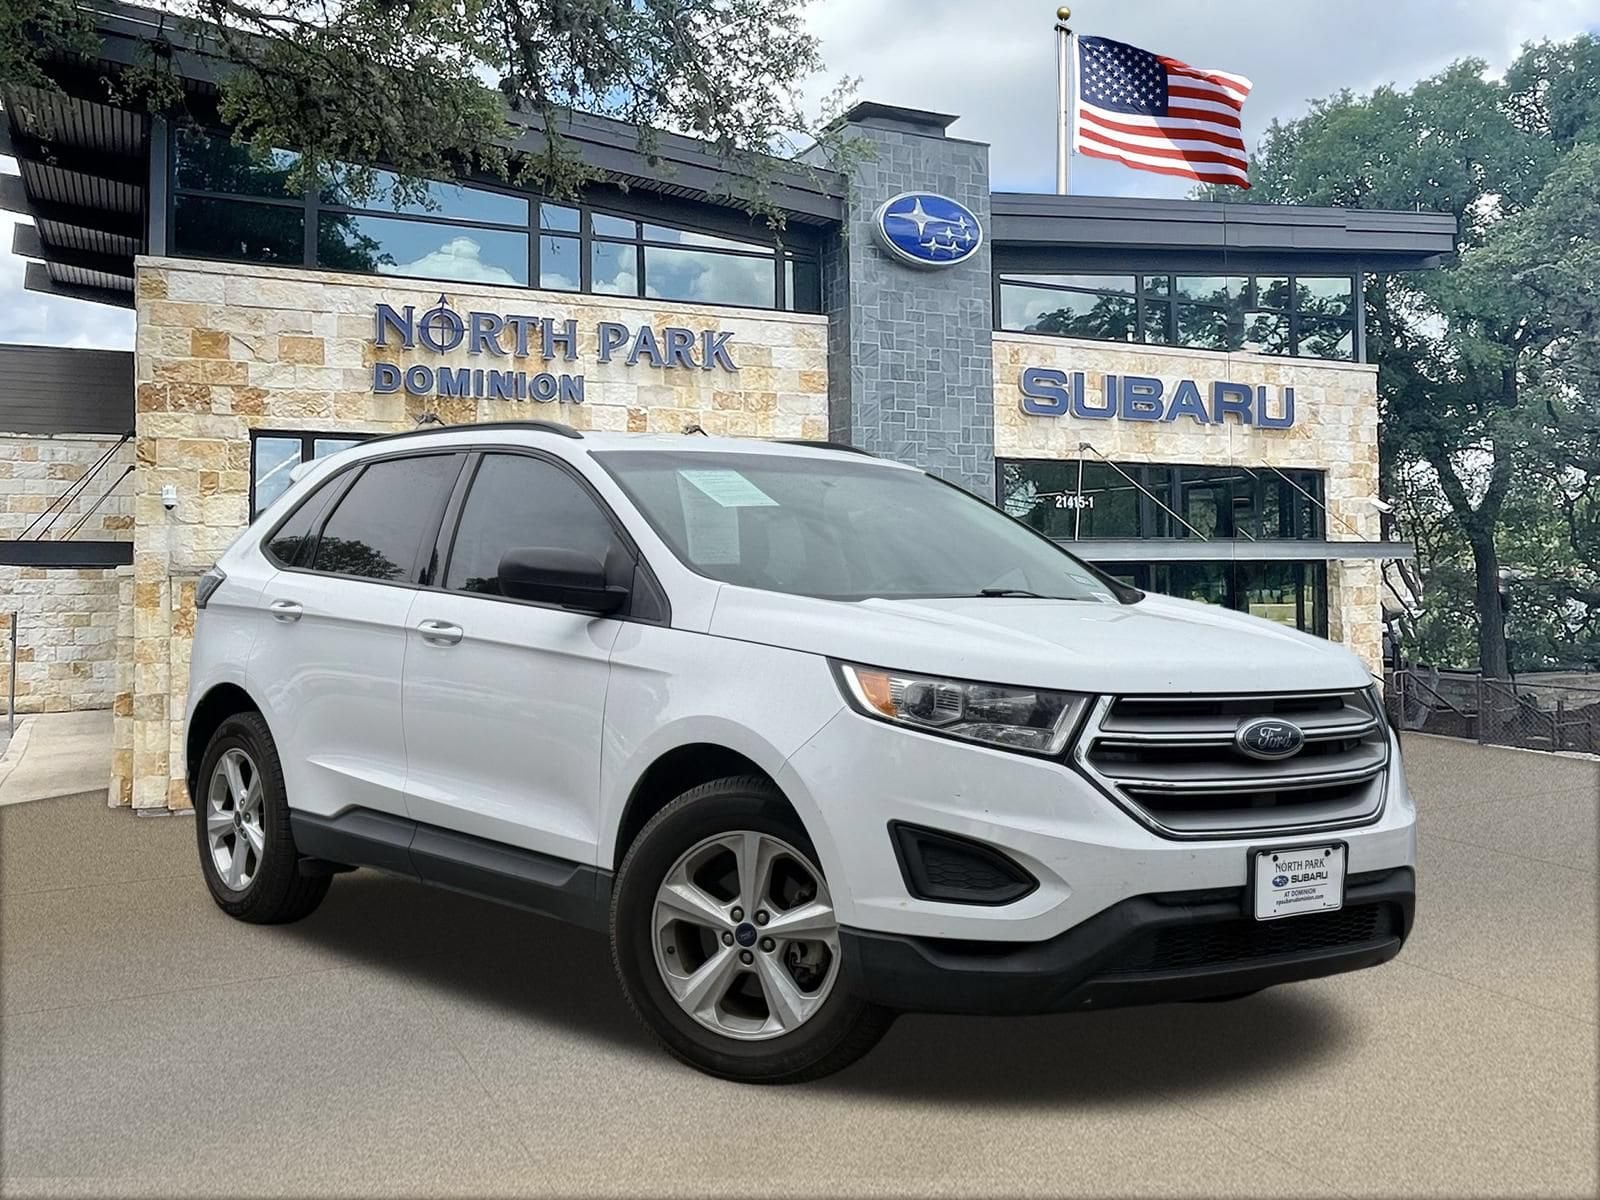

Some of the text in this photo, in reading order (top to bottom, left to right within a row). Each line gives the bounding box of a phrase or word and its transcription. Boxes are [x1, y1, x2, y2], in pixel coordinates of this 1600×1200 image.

[374, 302, 742, 373] NORTH PARK
[373, 361, 584, 404] DOMINION
[1019, 366, 1295, 431] SUBARU
[1258, 726, 1293, 749] Ford
[1275, 858, 1325, 873] NORTH PARK
[1291, 871, 1328, 884] SUBARU
[1283, 888, 1316, 898] AT DOMINION
